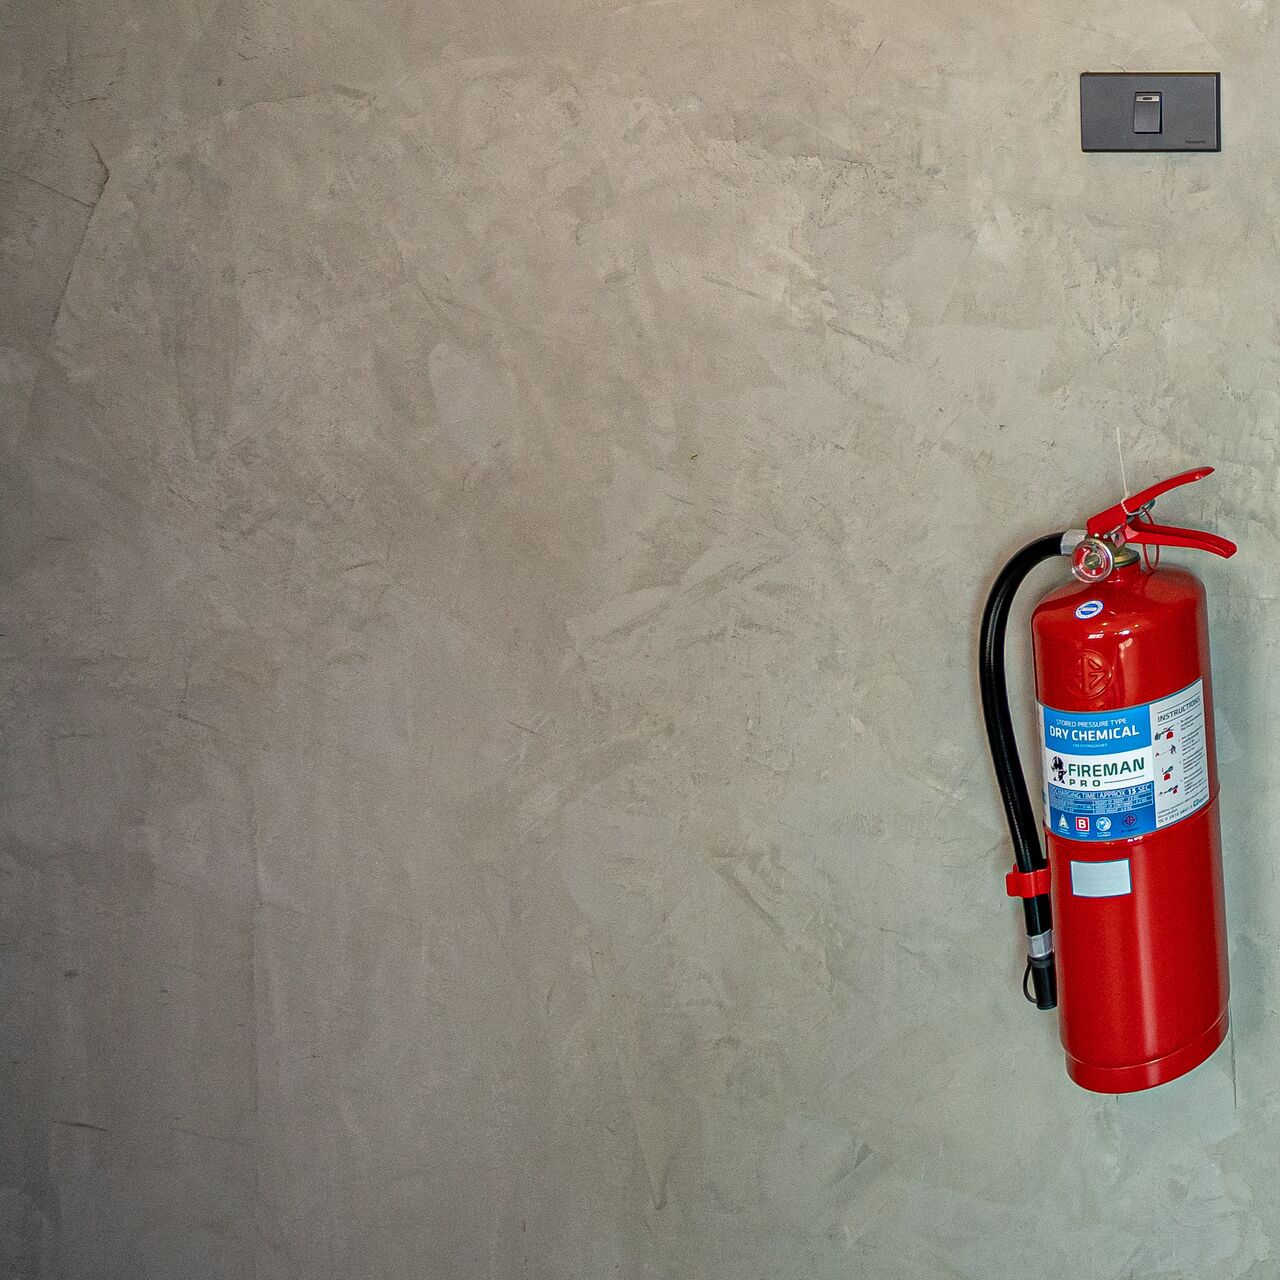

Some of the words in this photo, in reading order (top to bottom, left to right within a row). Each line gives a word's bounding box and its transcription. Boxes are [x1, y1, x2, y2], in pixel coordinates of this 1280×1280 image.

[1157, 696, 1201, 722] INSTRUCTIONS
[1056, 719, 1077, 727] STORED
[1077, 719, 1109, 728] PRESSURE
[1111, 718, 1127, 726] TYPE
[1049, 726, 1070, 739] DRY
[1071, 725, 1140, 741] CHEMICAL
[1068, 757, 1145, 778] FIREMAN
[1069, 779, 1101, 787] PRO
[1078, 819, 1087, 828] B
